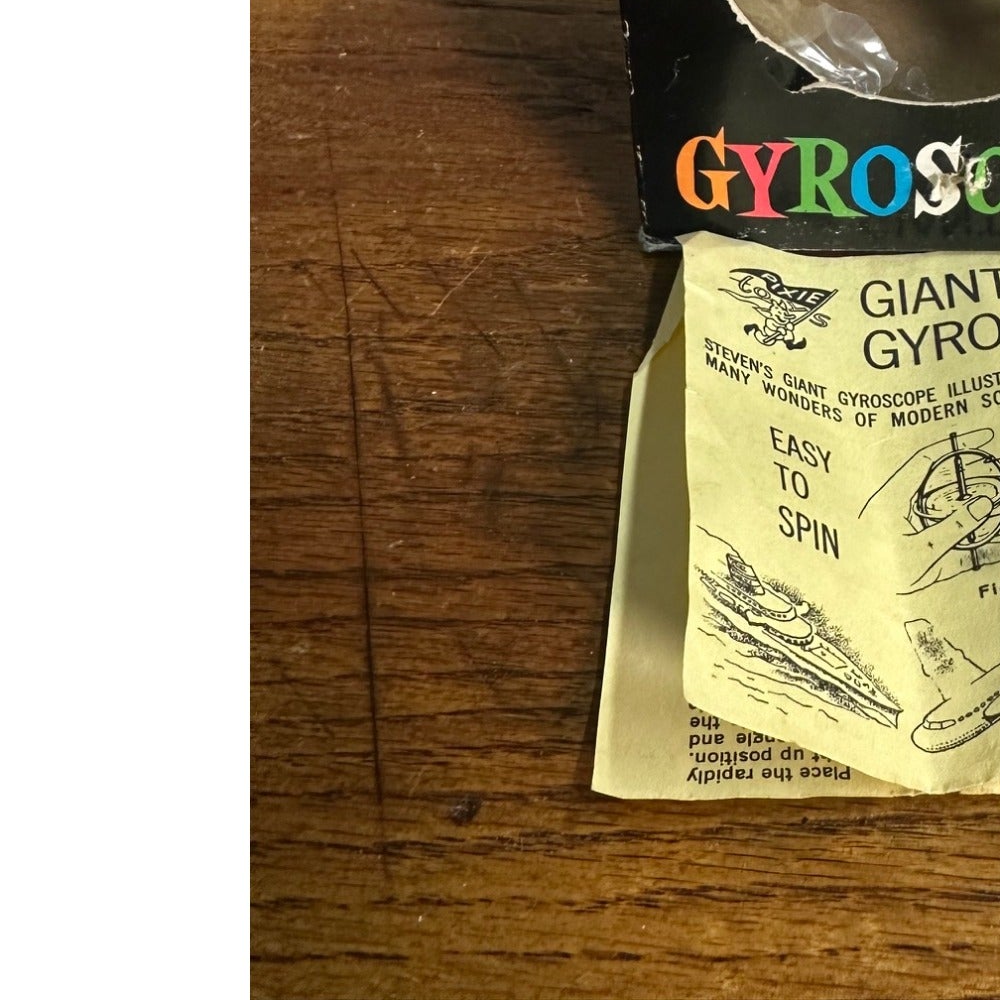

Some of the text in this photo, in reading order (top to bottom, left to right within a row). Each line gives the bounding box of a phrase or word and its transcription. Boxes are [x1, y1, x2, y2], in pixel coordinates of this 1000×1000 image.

[760, 272, 826, 305] PIXIE
[703, 336, 774, 381] STEVEN'S
[782, 371, 828, 400] GIANT
[837, 387, 937, 409] GYROSCOPE
[704, 354, 751, 386] MANY
[762, 379, 844, 424] WONDERS
[854, 412, 878, 428] OF
[890, 398, 969, 429] MODERN
[769, 426, 832, 474] EASY
[773, 460, 810, 500] TO
[778, 504, 840, 560] SPIN
[689, 715, 720, 730] the
[689, 733, 725, 749] and
[689, 747, 772, 766] position.
[780, 746, 804, 761] up
[686, 765, 851, 785] Place the rapidly
